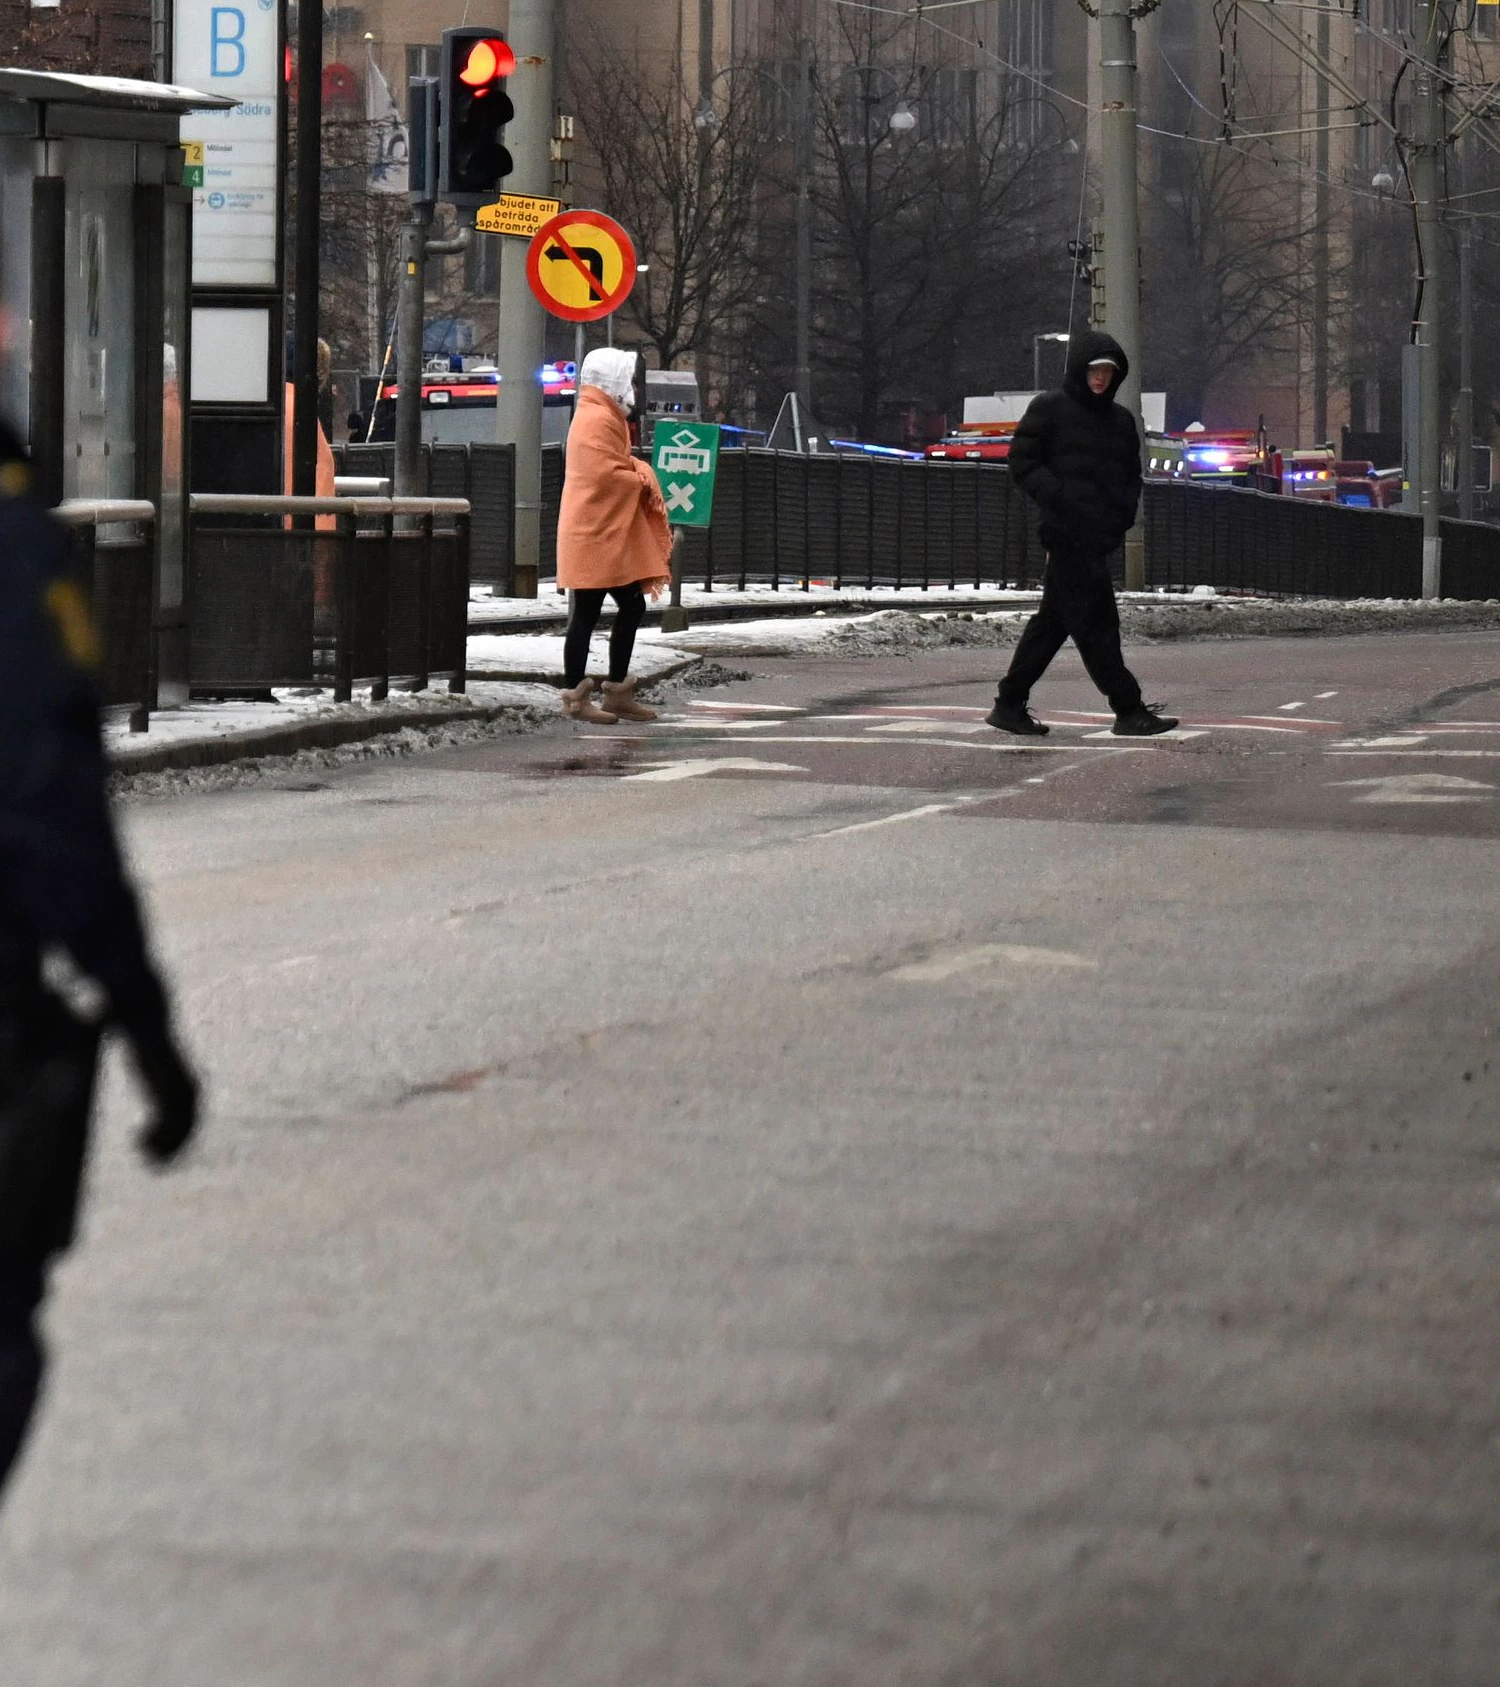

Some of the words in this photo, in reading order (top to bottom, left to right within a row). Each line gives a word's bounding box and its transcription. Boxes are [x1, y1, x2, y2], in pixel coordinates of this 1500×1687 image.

[210, 6, 246, 77] B
[236, 103, 271, 116] Södra
[192, 144, 201, 161] 2
[191, 169, 200, 183] 4
[500, 198, 536, 209] bjudet
[539, 203, 554, 213] att
[494, 209, 539, 223] beträda
[479, 219, 541, 234] spårområd
